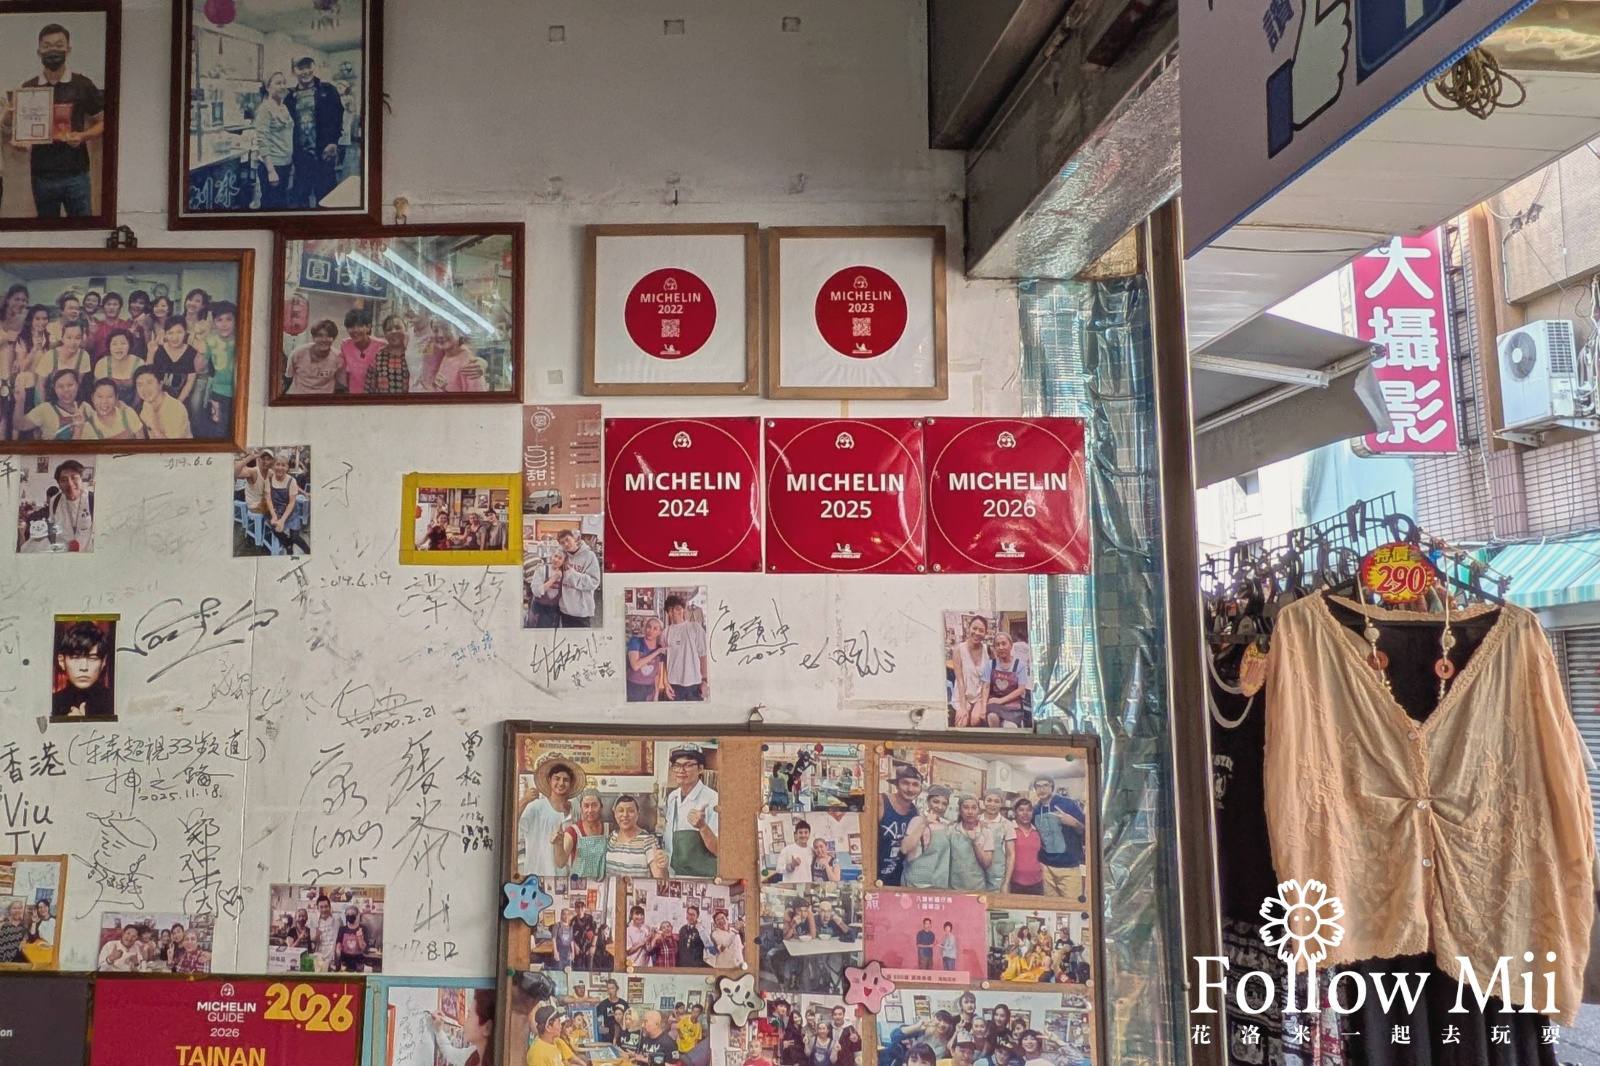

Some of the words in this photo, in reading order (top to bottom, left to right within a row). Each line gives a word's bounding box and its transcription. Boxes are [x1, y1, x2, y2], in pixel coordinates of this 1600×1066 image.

[640, 292, 702, 304] MICHELIN
[830, 290, 892, 302] MICHELIN
[657, 304, 684, 315] 2022
[848, 302, 875, 314] 2023
[625, 472, 741, 491] MICHELIN
[786, 473, 904, 492] MICHELIN
[948, 471, 1067, 491] MICHELIN
[657, 498, 709, 518] 2024
[820, 500, 872, 519] 2025
[982, 499, 1036, 518] 2026
[1374, 546, 1410, 564] 特價
[1374, 564, 1426, 595] 290
[0, 741, 67, 784] 香港
[3, 792, 54, 828] Viu
[5, 830, 47, 855] TV
[196, 1001, 257, 1013] MICHELIN
[263, 981, 354, 1033] 2026
[207, 1012, 245, 1023] GUIDE
[210, 1028, 240, 1038] 2026
[176, 1045, 266, 1066] TAINAN
